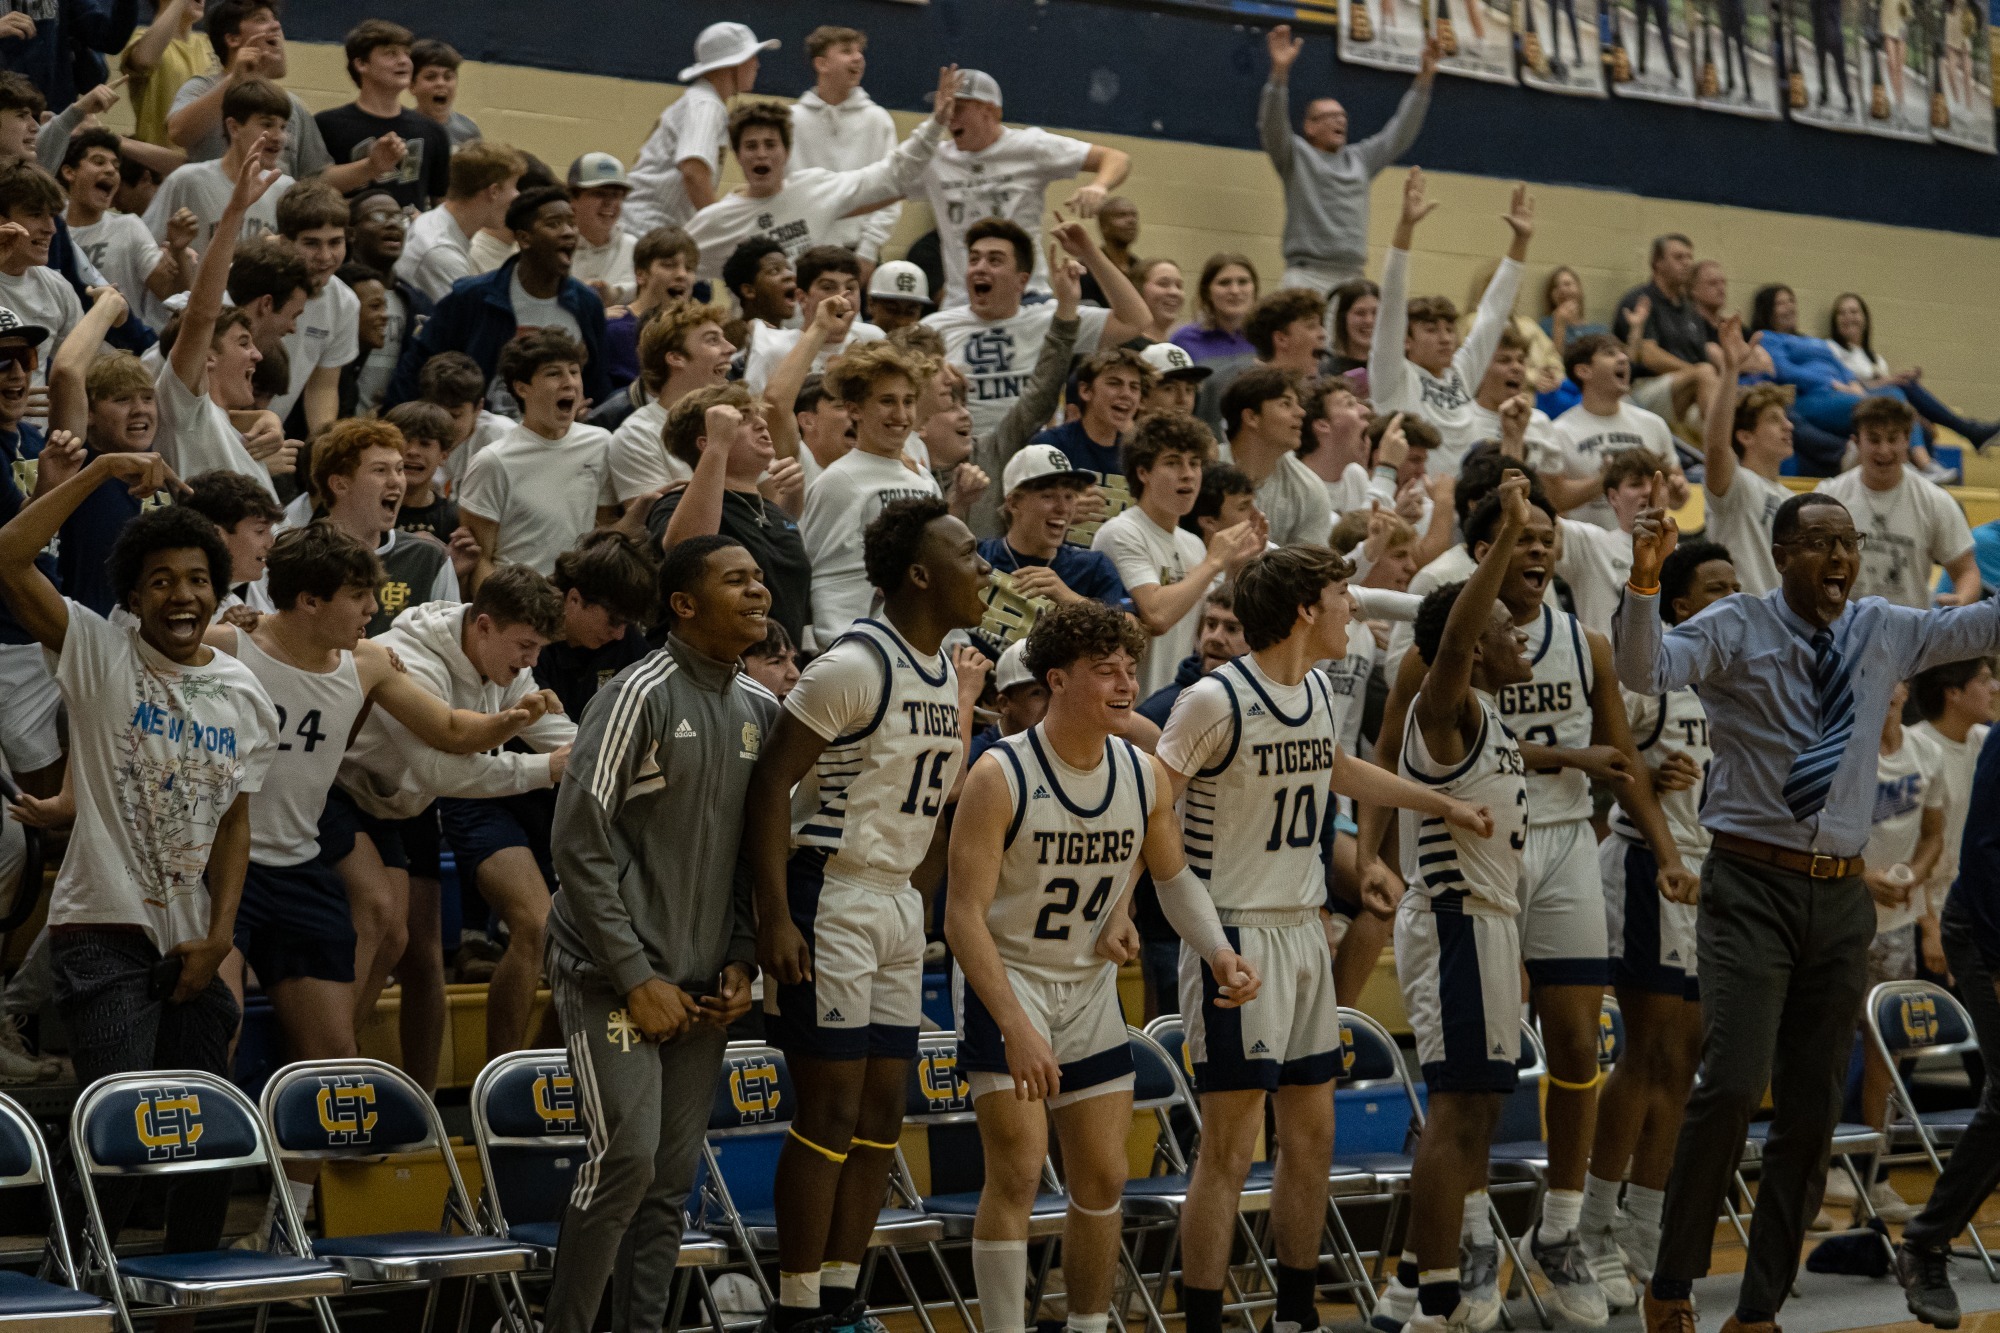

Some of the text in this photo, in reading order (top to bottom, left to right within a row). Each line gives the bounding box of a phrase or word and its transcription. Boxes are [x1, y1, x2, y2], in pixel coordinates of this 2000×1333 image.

[1500, 682, 1571, 715] GERS
[131, 702, 237, 758] NEW YORK
[674, 730, 697, 739] adidas
[1253, 738, 1333, 776] TIGERS
[1032, 792, 1051, 800] adidas
[1266, 785, 1316, 852] 10
[1033, 829, 1135, 866] TIGERS
[1033, 877, 1114, 940] 24
